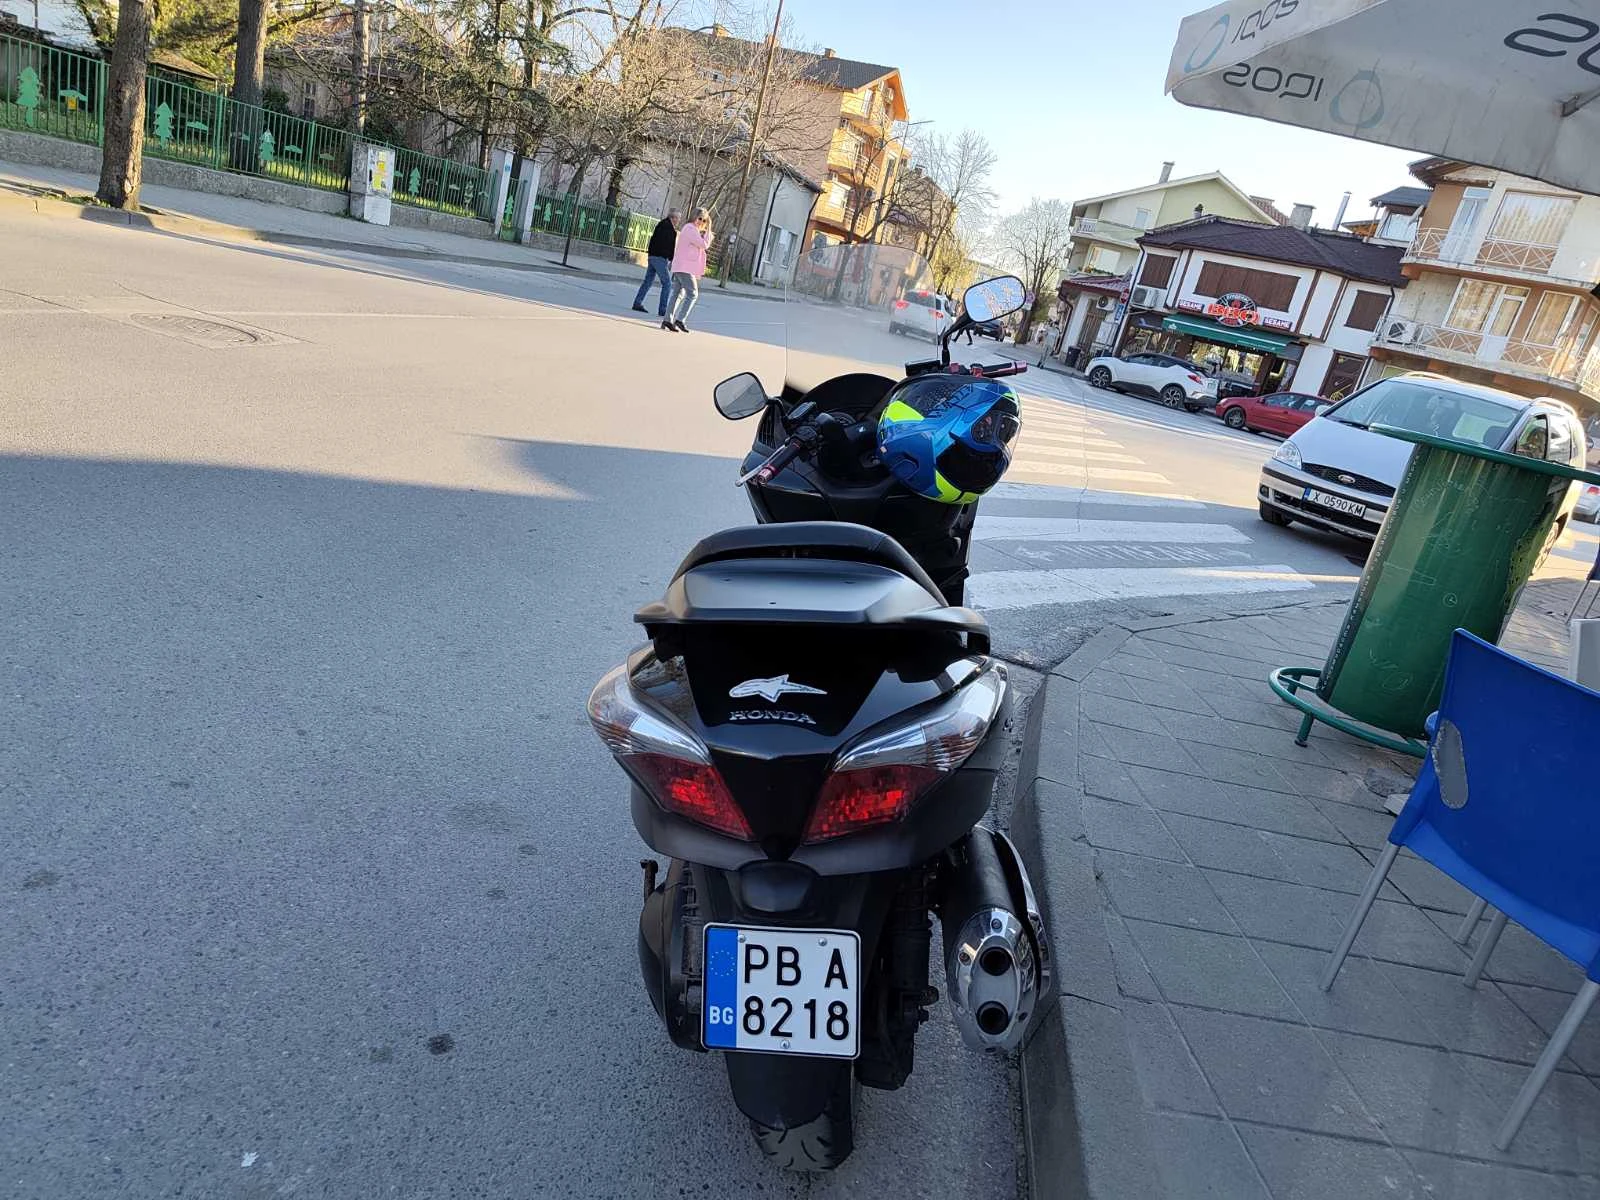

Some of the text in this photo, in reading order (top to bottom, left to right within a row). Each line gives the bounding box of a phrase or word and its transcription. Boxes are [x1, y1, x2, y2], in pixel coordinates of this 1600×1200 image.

[1265, 317, 1290, 328] SESAME
[1313, 491, 1321, 502] X
[729, 710, 816, 724] HONDA
[744, 943, 849, 989] PB A
[709, 1005, 734, 1025] BG
[742, 995, 850, 1041] 8218
